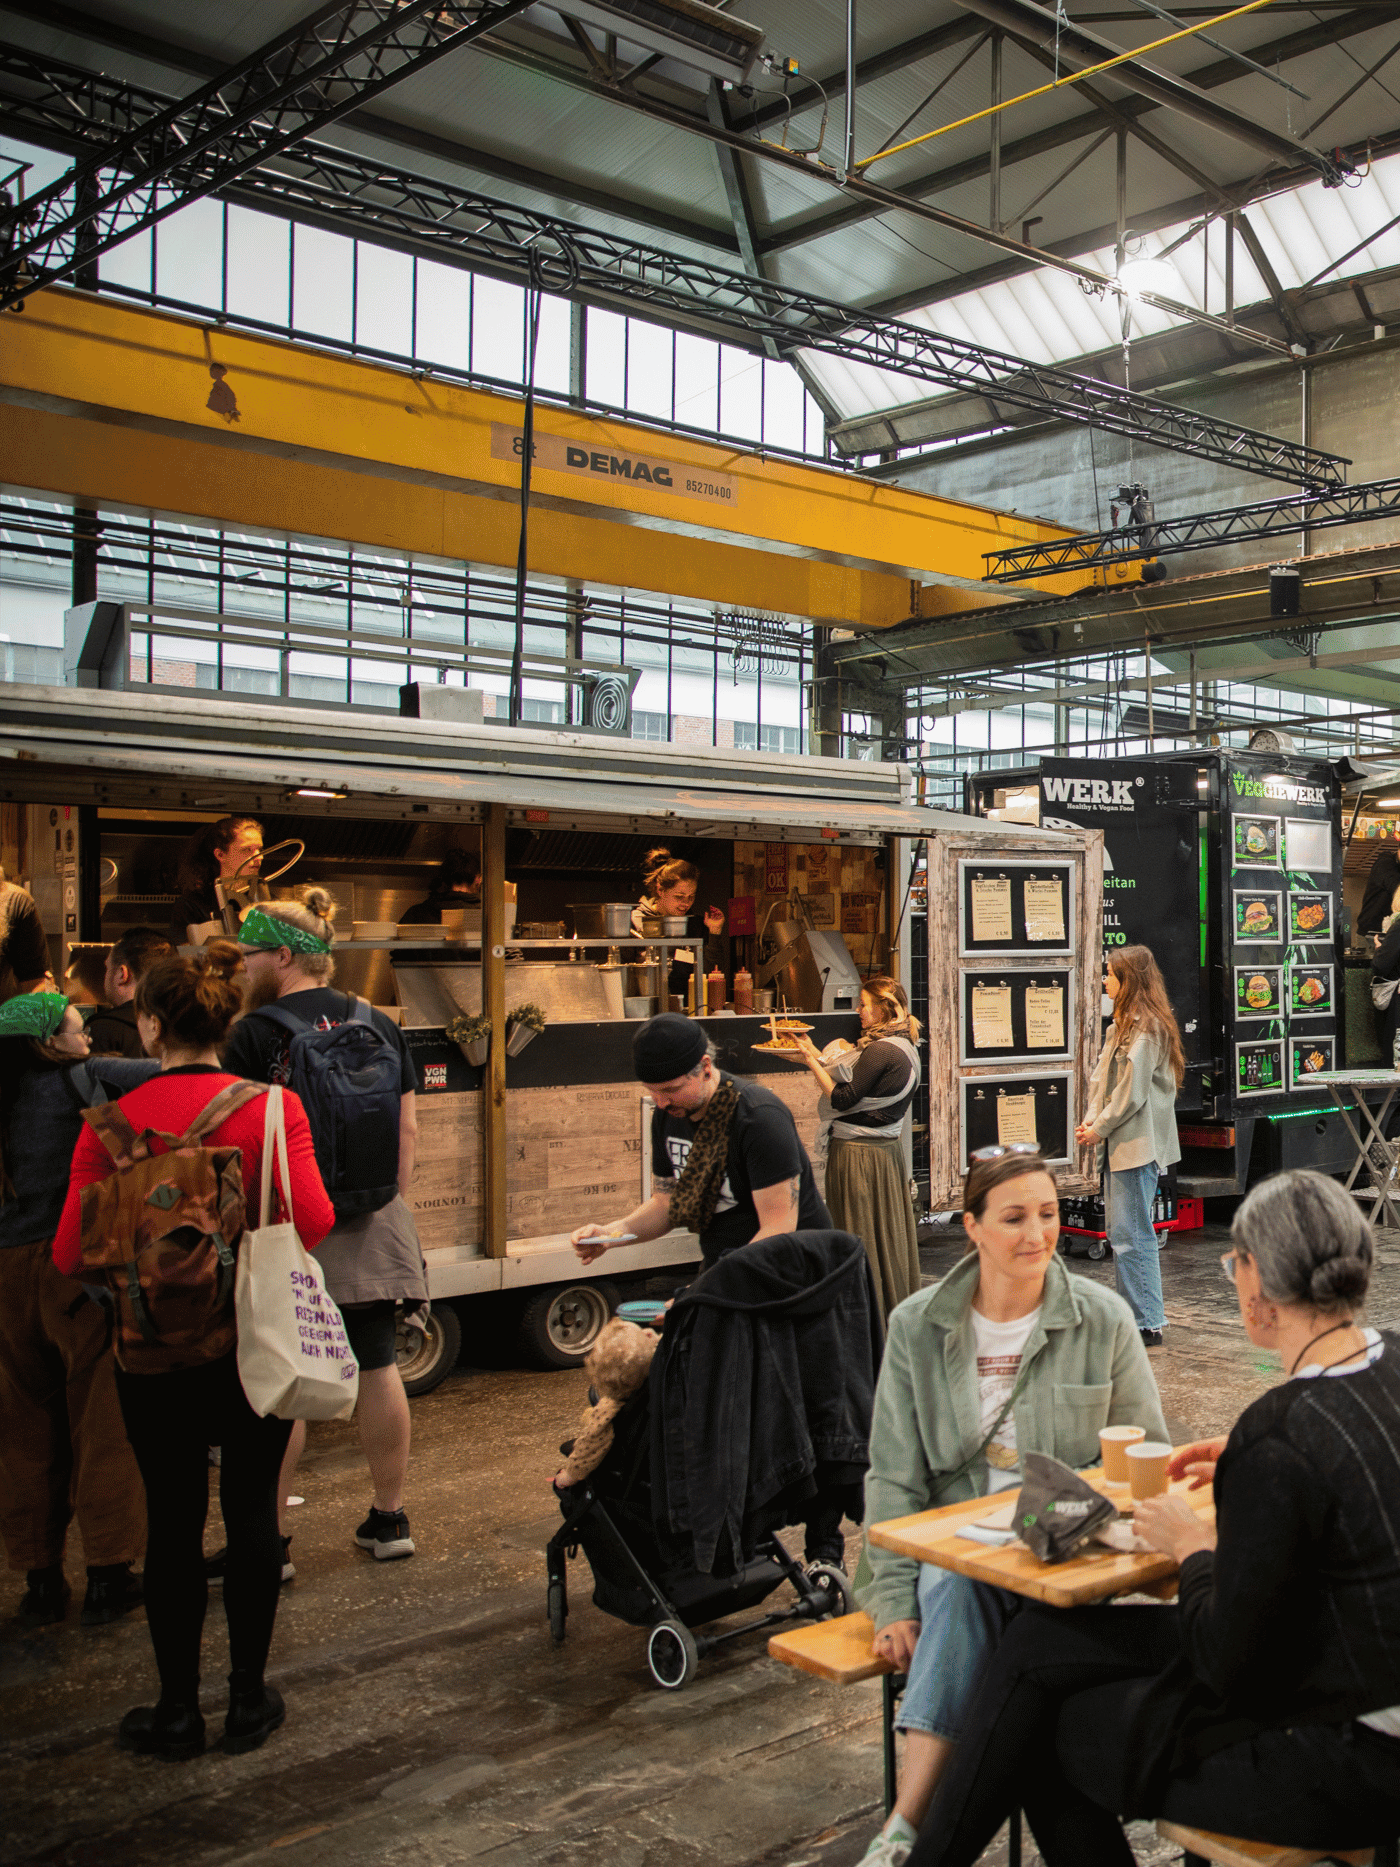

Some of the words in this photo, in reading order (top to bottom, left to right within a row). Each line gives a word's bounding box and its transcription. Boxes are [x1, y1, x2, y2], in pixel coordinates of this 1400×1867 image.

[566, 446, 674, 488] DEMAG
[685, 479, 732, 500] 85270400
[1067, 803, 1092, 812] Healthy
[1098, 804, 1118, 812] Vegan
[768, 872, 785, 889] OK
[1103, 875, 1136, 888] eitan
[1102, 899, 1115, 907] us
[1102, 914, 1121, 926] ILL
[425, 1067, 447, 1076] VGN
[424, 1076, 447, 1084] PWR
[414, 1196, 466, 1210] LONDON
